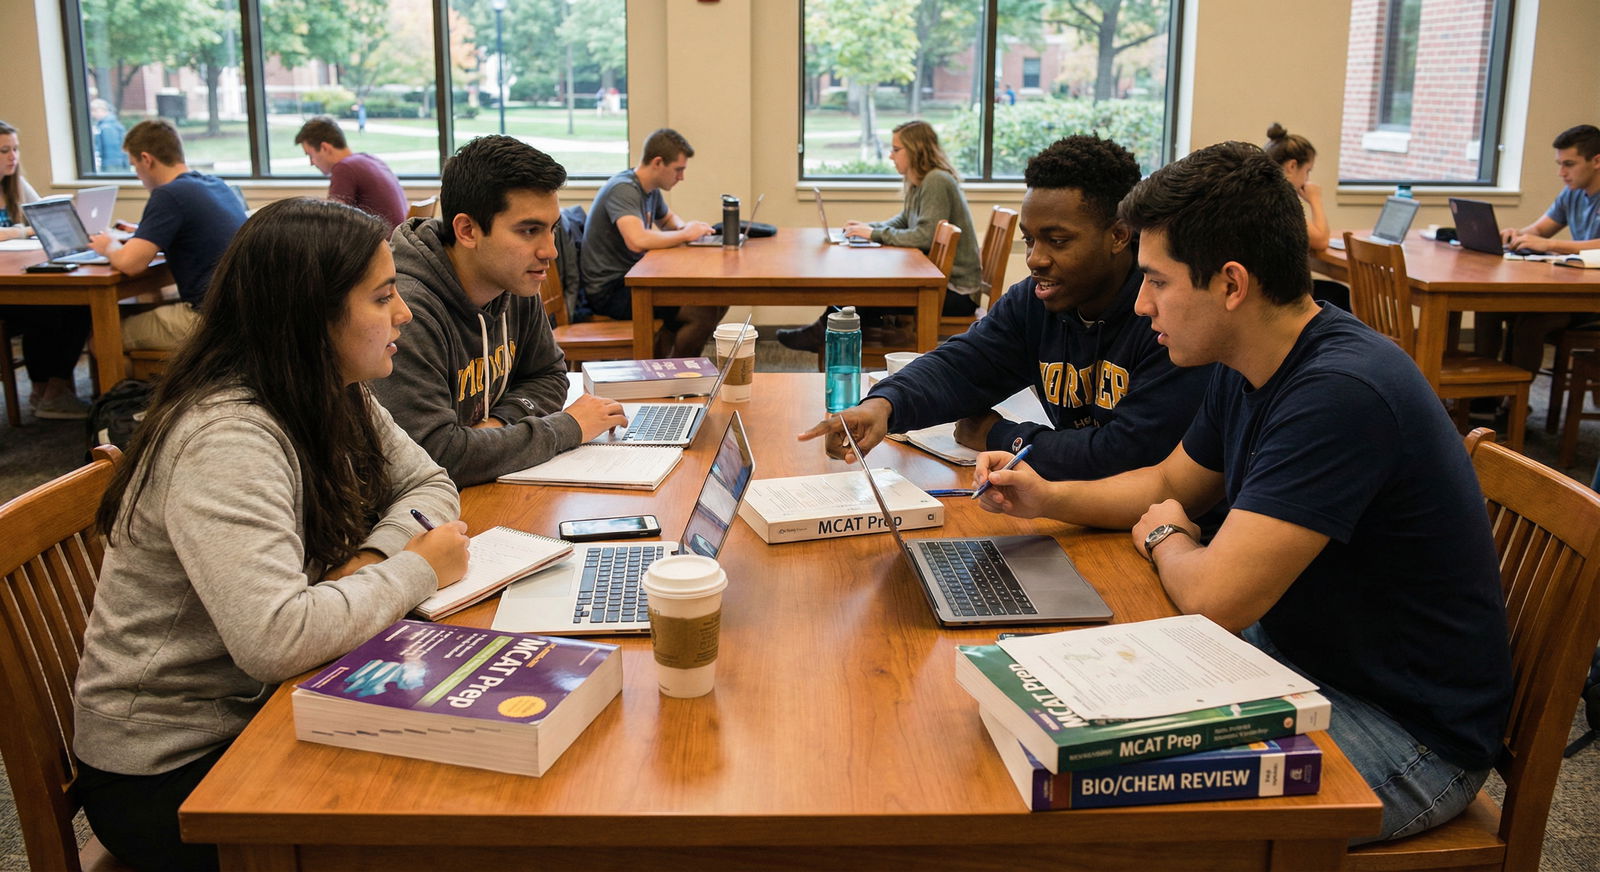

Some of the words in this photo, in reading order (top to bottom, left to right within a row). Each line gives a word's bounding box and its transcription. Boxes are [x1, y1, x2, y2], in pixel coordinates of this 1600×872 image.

[818, 516, 864, 535] MCAT
[488, 638, 547, 676] MCAT
[446, 675, 505, 708] Prep
[1032, 693, 1090, 728] MCAT
[1119, 736, 1164, 758] MCAT
[1168, 733, 1201, 751] Prep
[1081, 771, 1176, 797] BIO/CHEM
[1180, 769, 1250, 790] REVIEW
